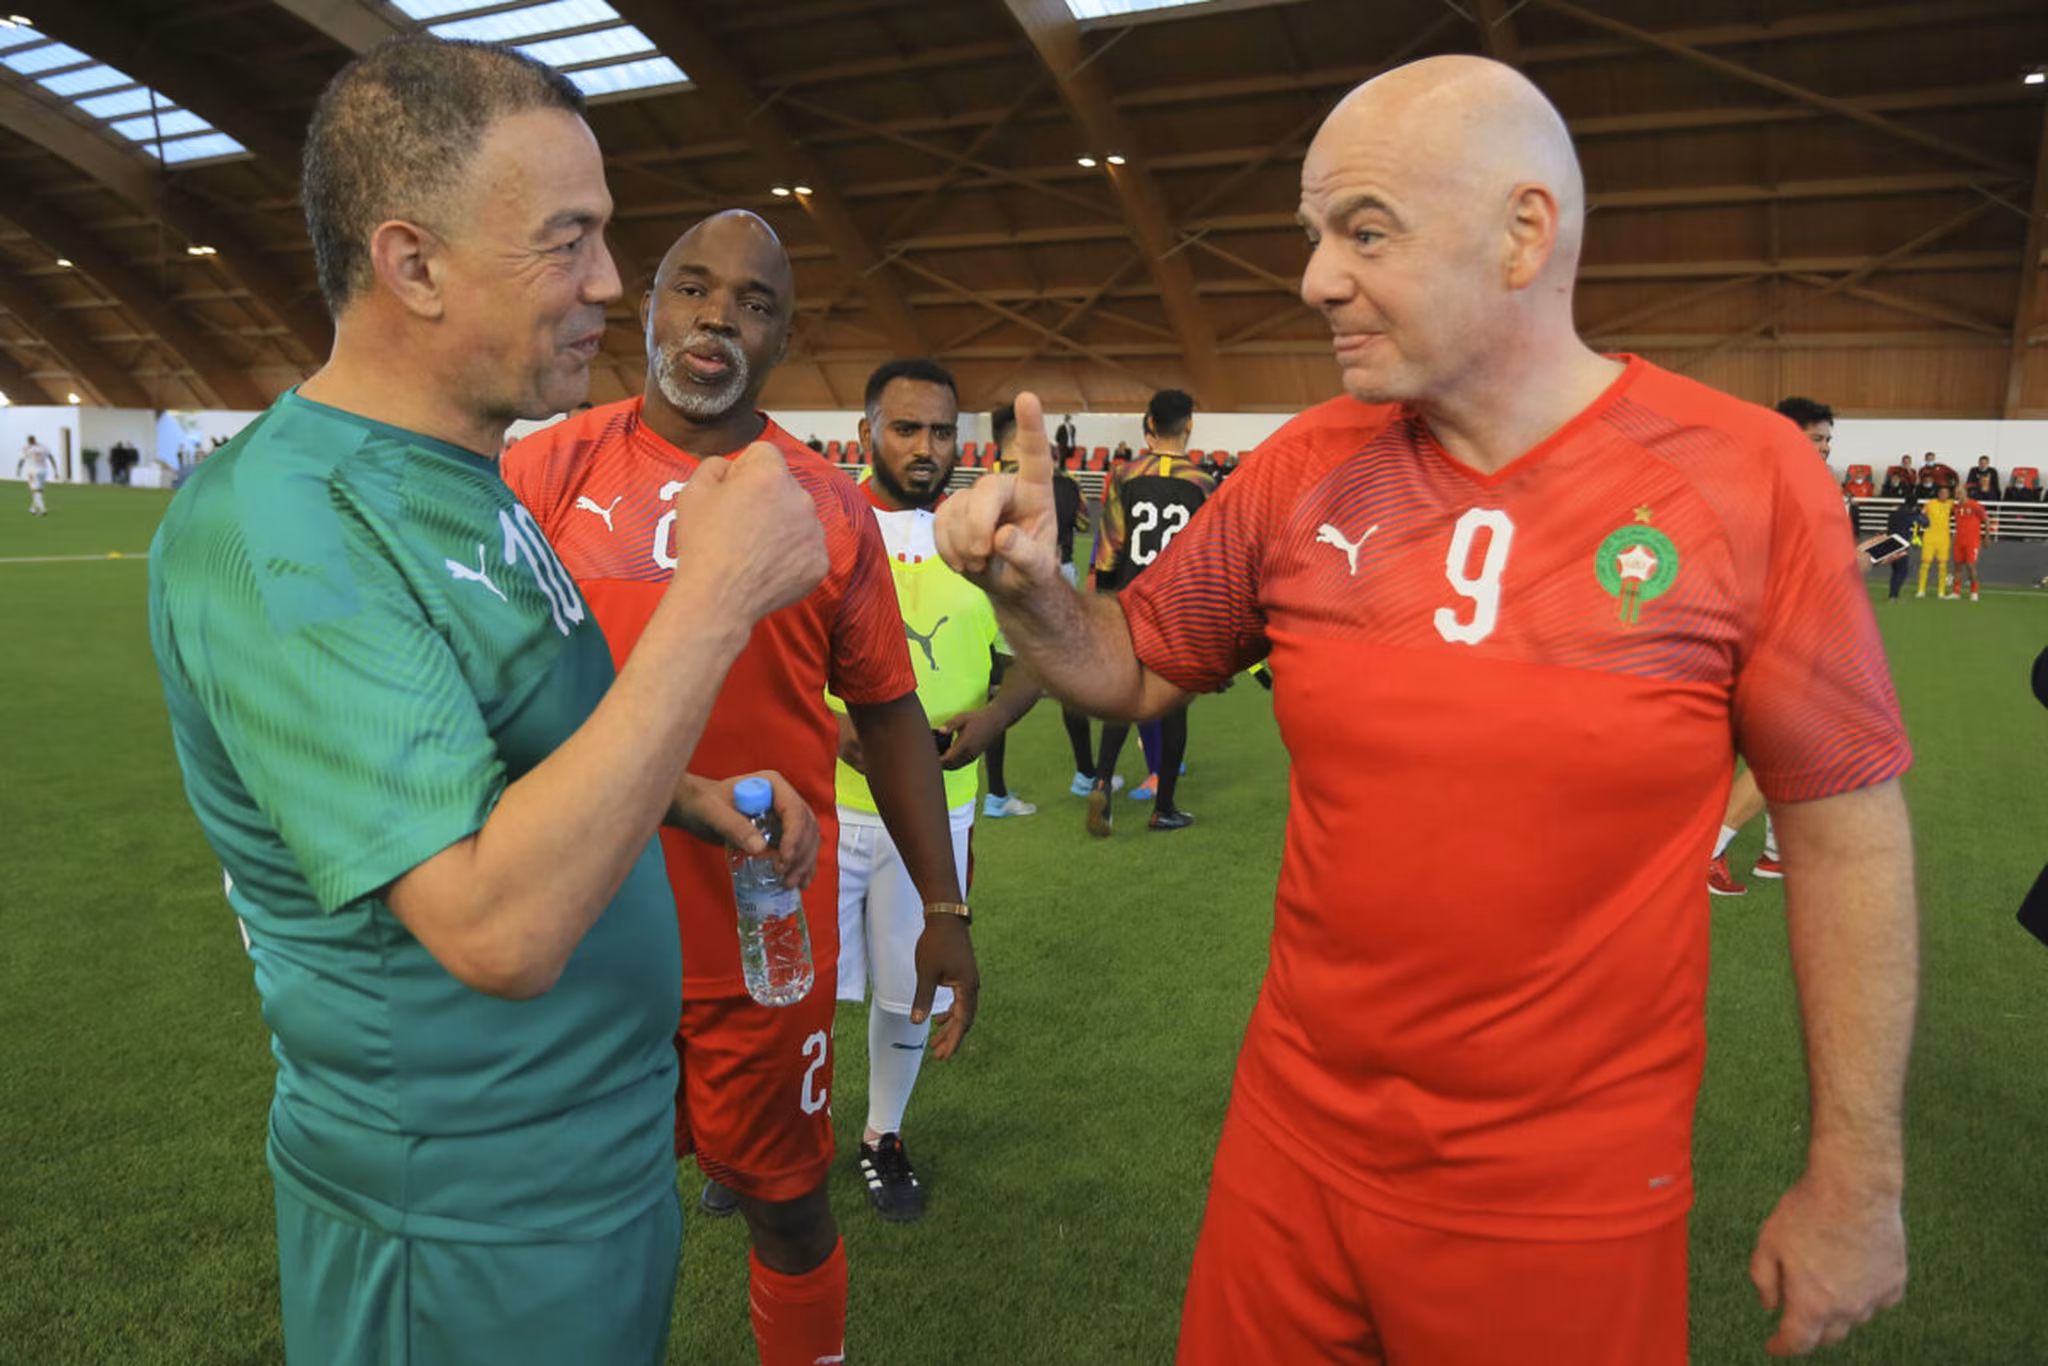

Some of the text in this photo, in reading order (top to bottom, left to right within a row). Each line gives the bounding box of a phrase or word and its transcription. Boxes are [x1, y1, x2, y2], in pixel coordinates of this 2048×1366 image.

[499, 502, 585, 637] 10
[1130, 501, 1190, 566] 22
[1433, 507, 1515, 645] 9
[800, 1022, 836, 1117] 2
